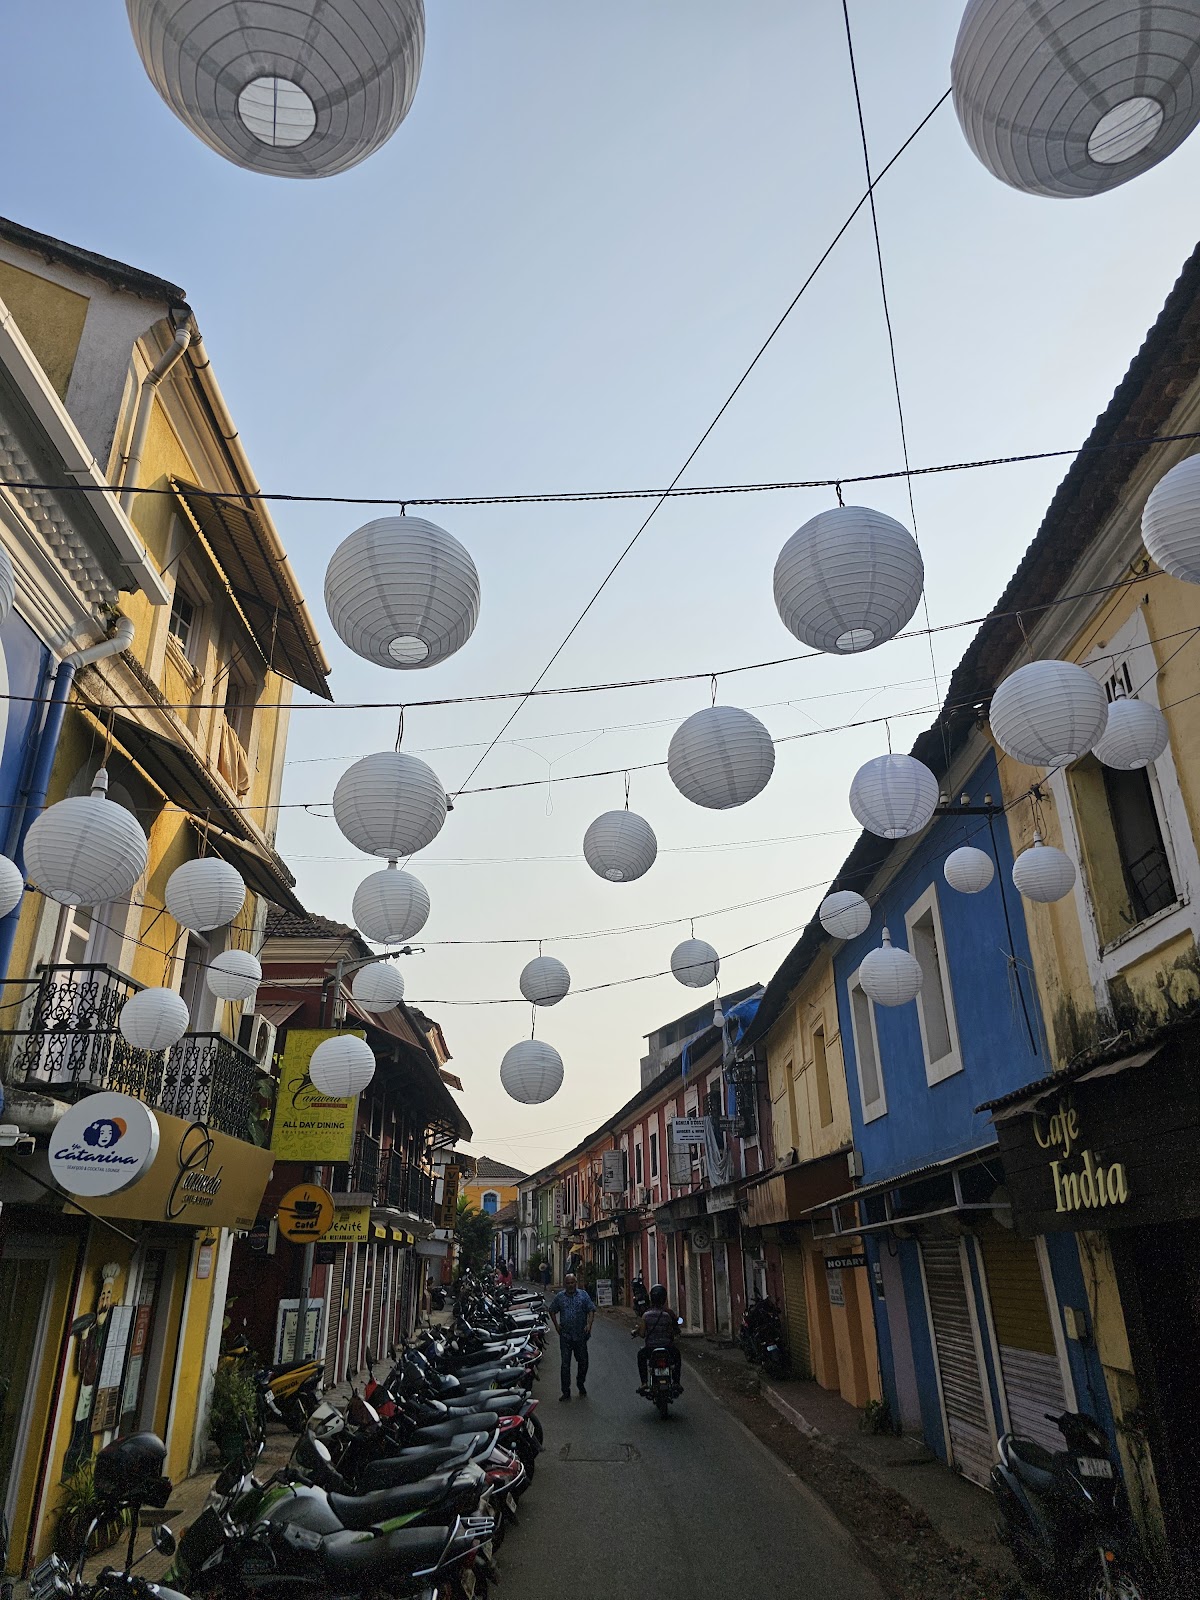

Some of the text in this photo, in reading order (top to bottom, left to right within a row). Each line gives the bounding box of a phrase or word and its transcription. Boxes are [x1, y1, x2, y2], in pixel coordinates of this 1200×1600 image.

[54, 1148, 139, 1165] Catarina
[443, 1172, 457, 1222] VENITE
[1049, 1150, 1128, 1213] India
[827, 1257, 865, 1268] NOTARY
